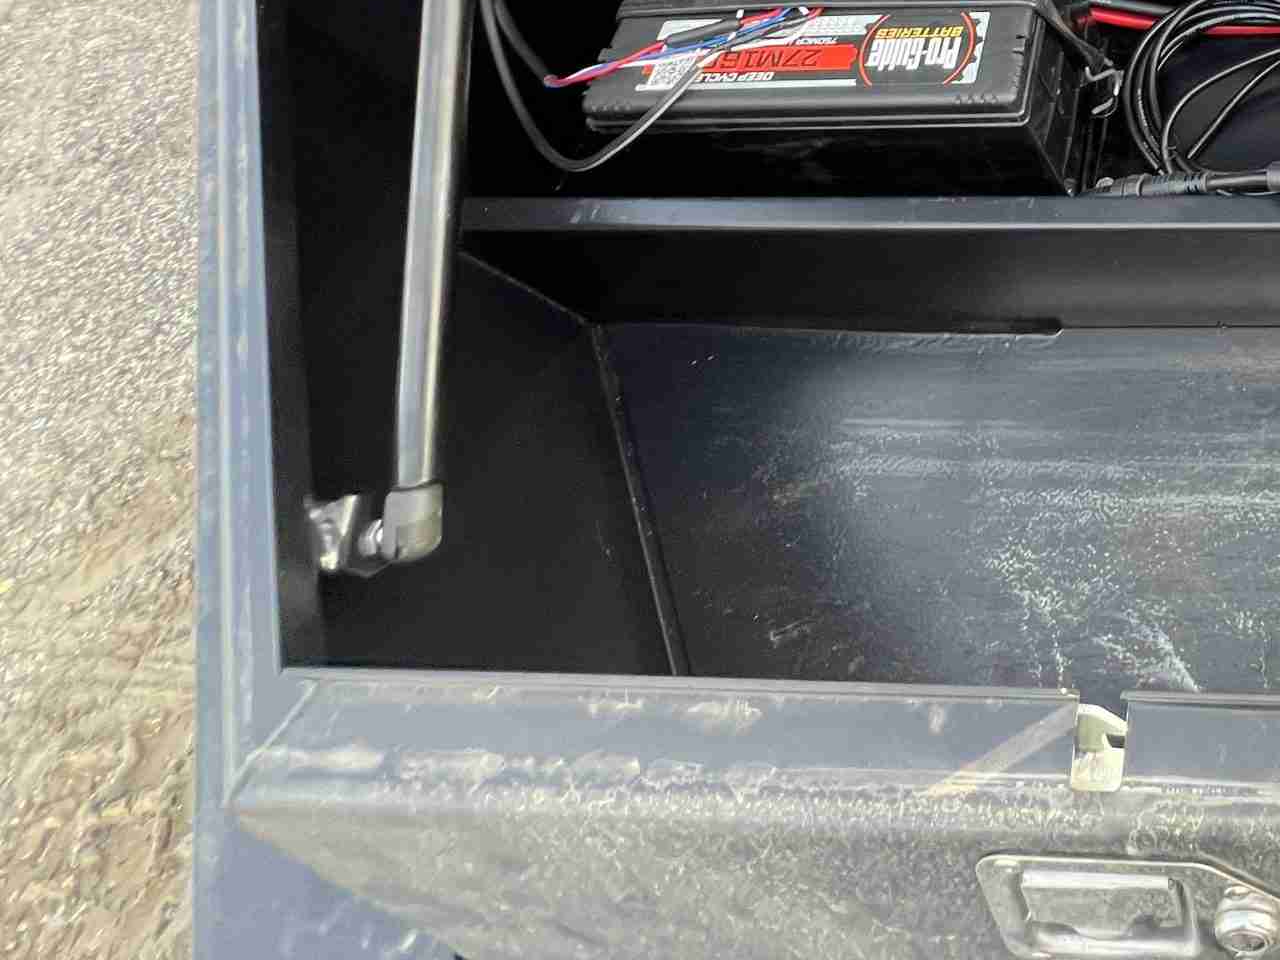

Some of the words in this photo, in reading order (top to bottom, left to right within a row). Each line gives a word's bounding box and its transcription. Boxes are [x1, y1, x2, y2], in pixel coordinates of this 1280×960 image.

[876, 26, 964, 38] BATTERIES
[866, 36, 962, 71] Pro-Guide
[737, 71, 775, 81] DEEP
